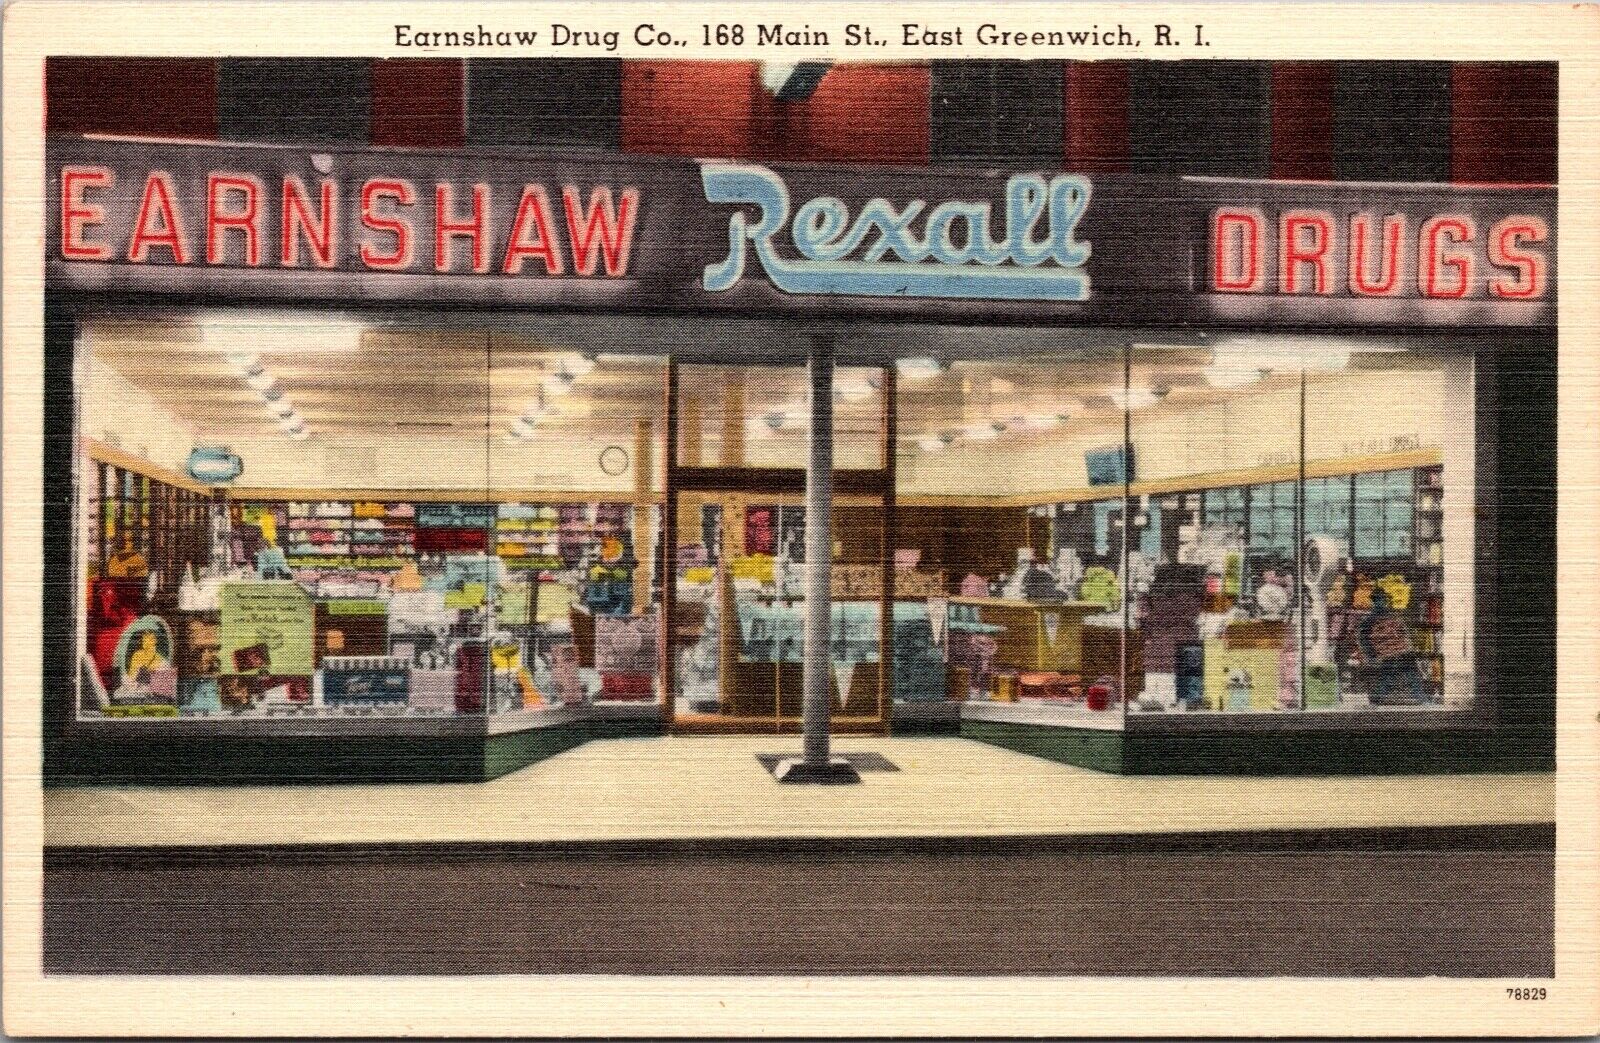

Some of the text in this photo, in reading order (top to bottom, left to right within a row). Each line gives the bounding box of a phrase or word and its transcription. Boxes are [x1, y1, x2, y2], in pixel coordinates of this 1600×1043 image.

[61, 163, 1549, 300] EARNSHAW Rexall DRUGS
